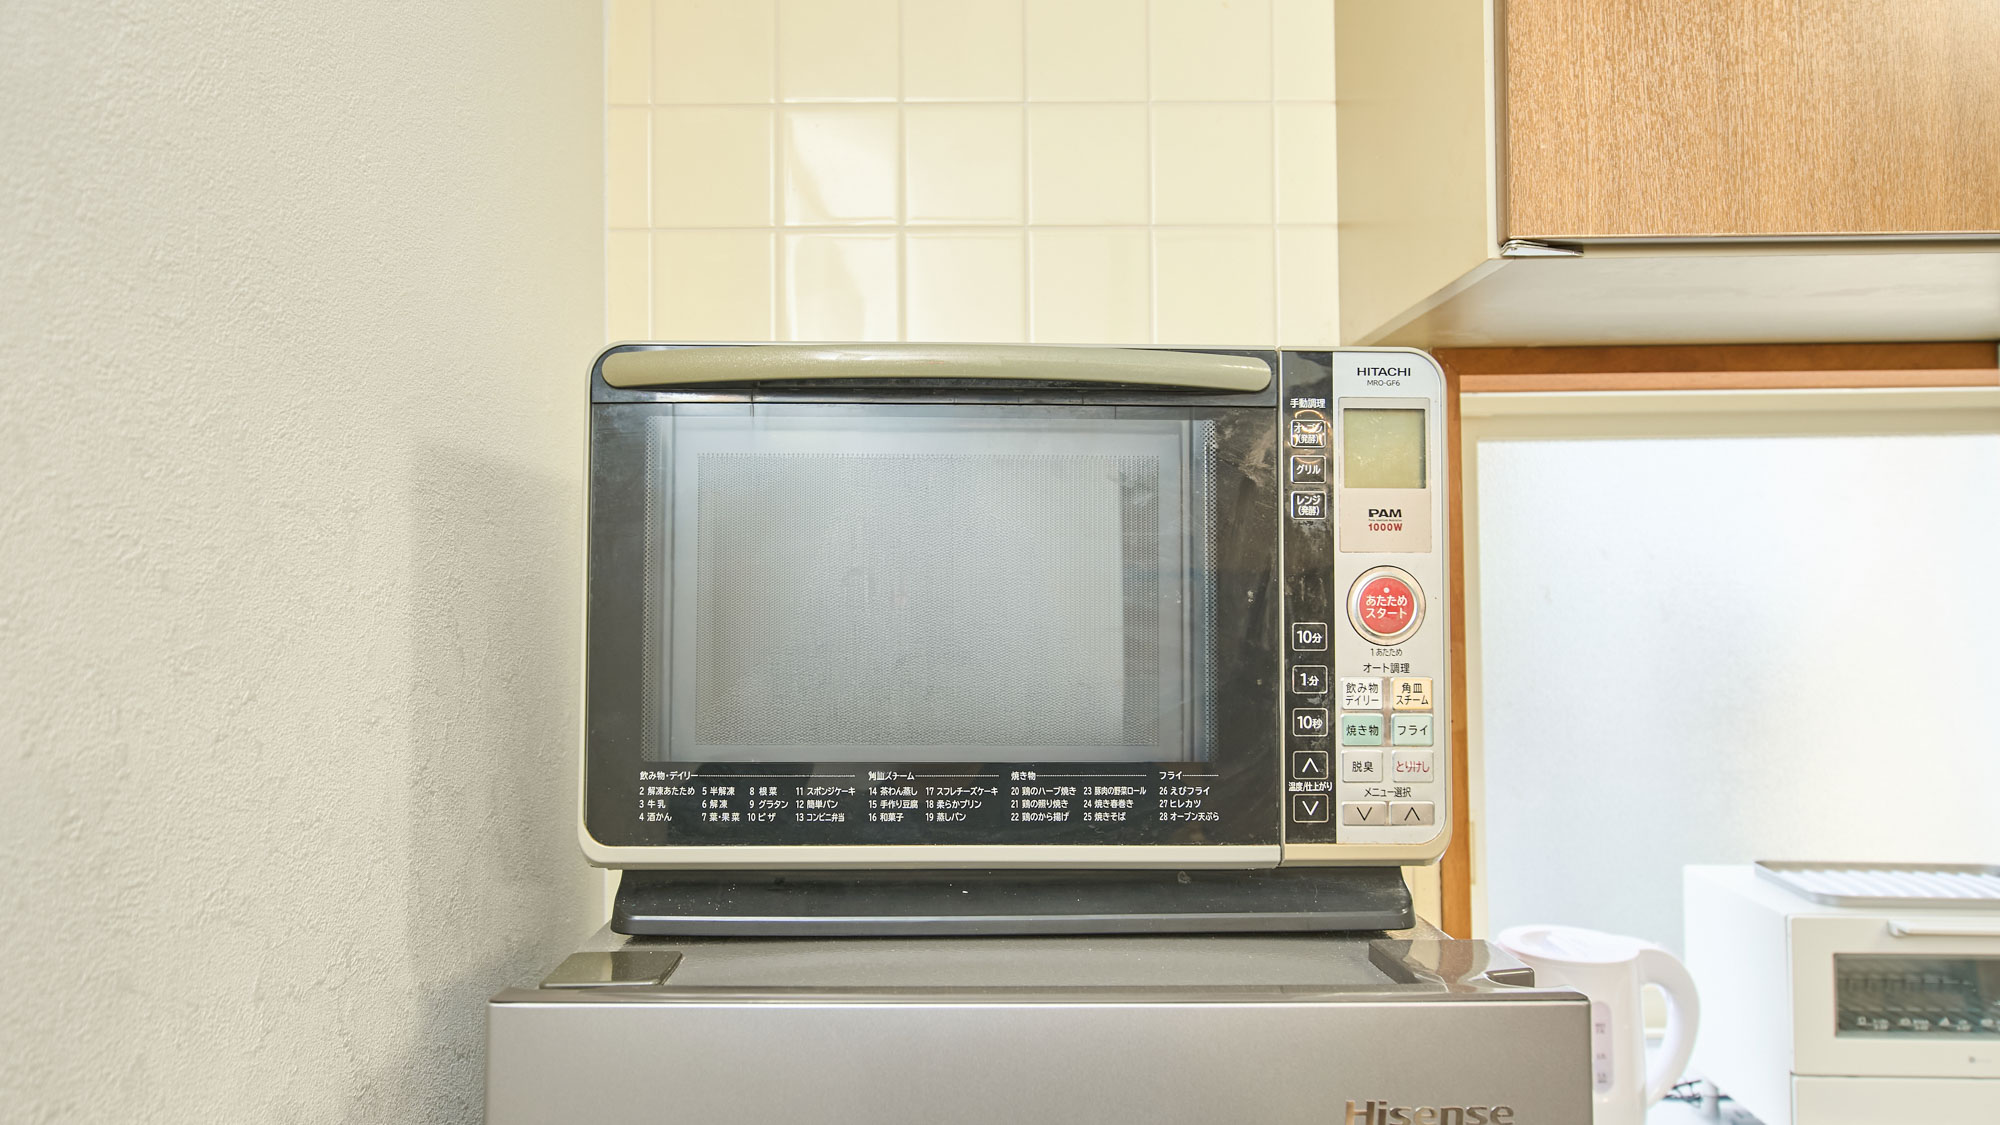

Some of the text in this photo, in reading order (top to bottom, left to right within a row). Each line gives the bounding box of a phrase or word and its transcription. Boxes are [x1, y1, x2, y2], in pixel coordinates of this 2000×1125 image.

[1357, 367, 1411, 377] HITACHI
[1290, 398, 1326, 409] 手動調理
[1296, 464, 1321, 475] グリル
[1297, 495, 1321, 506] レンジ
[1368, 509, 1402, 518] PAM
[1368, 523, 1403, 532] 1000W
[1365, 595, 1408, 607] あたため
[1366, 608, 1407, 619] スタート
[1297, 630, 1322, 644] 10分
[1363, 663, 1410, 674] オート調理
[1300, 673, 1319, 686] 1分
[1346, 683, 1379, 694] 飲み物
[1402, 683, 1423, 694] 角皿
[1346, 695, 1379, 706] デイリー
[1396, 695, 1429, 705] スチーム
[1297, 716, 1323, 729] 10秒
[1346, 725, 1379, 736] 焼き物
[1397, 725, 1428, 736] フライ
[1352, 761, 1374, 772] 脱臭
[1396, 762, 1430, 773] とりけし
[1011, 771, 1036, 781] 焼き物
[1159, 771, 1183, 780] フライ
[639, 786, 695, 796] 2 解凍あたため
[702, 786, 735, 796] 5 半解凍
[749, 786, 755, 796] 8
[796, 786, 856, 796] 11 スポンジケーキ
[868, 786, 918, 796] 14 茶わん蒸し
[925, 786, 999, 796] 17 スフレチーズケーキ
[1010, 786, 1020, 796] 20
[1083, 786, 1092, 796] 23
[1159, 786, 1210, 796] 26 えびフライ
[1364, 787, 1412, 798] メニュー選択
[639, 799, 645, 809] 3
[701, 799, 707, 809] 6
[749, 799, 789, 809] 9 グラタン
[795, 799, 839, 809] 12 簡単パン
[868, 799, 919, 809] 15 手作り豆腐
[925, 799, 934, 809] 18
[1010, 799, 1019, 809] 21
[1083, 799, 1134, 809] 24 焼き春巻き
[1159, 799, 1202, 809] 27 ヒレカツ
[638, 812, 672, 822] 4 酒かん
[701, 812, 707, 822] 7
[747, 812, 756, 822] 10
[795, 812, 845, 822] 13 コンビニ弁当
[868, 812, 904, 822] 16 和菓子
[925, 812, 967, 822] 19 蒸しパン
[1010, 812, 1070, 822] 22 鶏のから揚げ
[1083, 812, 1127, 822] 25 焼きそば
[1159, 812, 1220, 822] 28 オーブン天ぷら
[1345, 1100, 1514, 1125] Hisense
